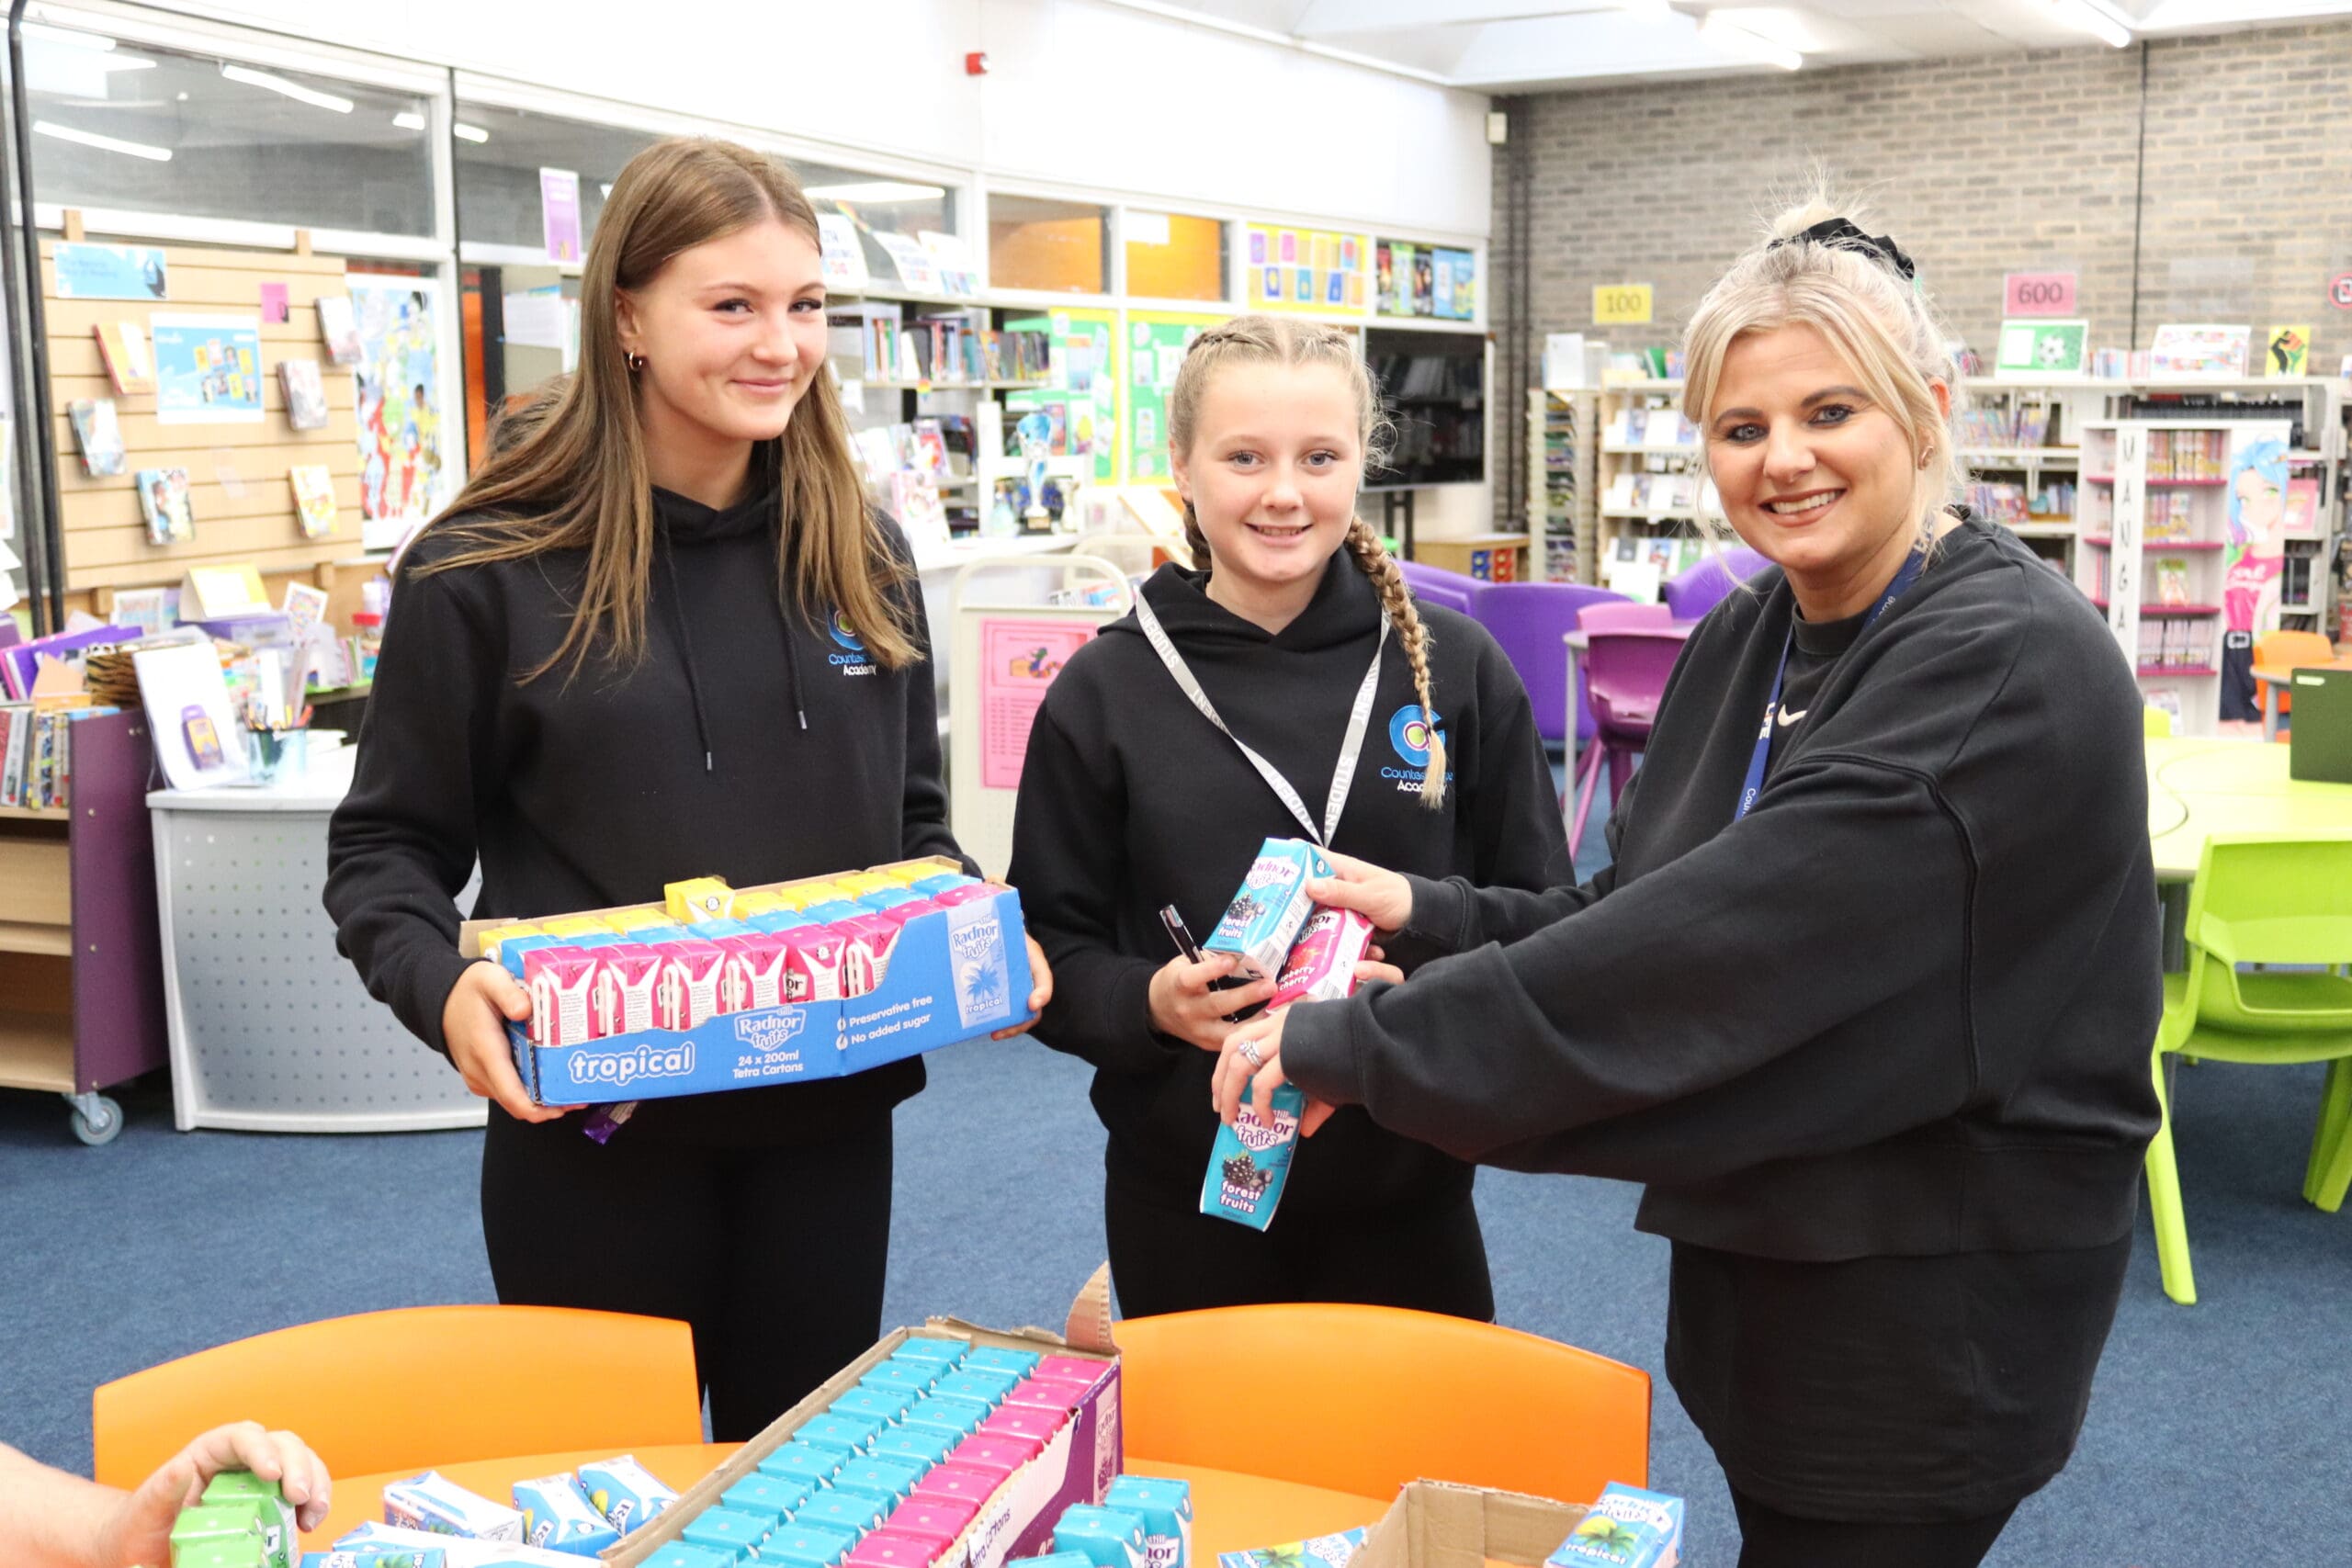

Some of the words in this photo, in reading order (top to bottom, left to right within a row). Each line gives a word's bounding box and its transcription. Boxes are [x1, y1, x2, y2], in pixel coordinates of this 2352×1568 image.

[1606, 292, 1642, 313] 100
[2018, 282, 2064, 304] 600
[1140, 612, 1180, 669] STUDENT
[953, 924, 998, 947] Radnor
[1217, 927, 1244, 938] fruits
[961, 936, 993, 959] fruits
[1279, 975, 1309, 991] cherry
[849, 1002, 910, 1027] Preservative
[911, 996, 933, 1009] free
[966, 995, 1003, 1014] tropical
[739, 1014, 802, 1036] Radnor
[851, 1033, 866, 1045] No
[868, 1021, 900, 1040] added
[902, 1014, 932, 1029] sugar
[752, 1029, 789, 1051] fruits
[572, 1043, 691, 1083] tropical
[738, 1055, 753, 1066] 24
[754, 1056, 763, 1065] x
[763, 1049, 799, 1064] 200ml
[733, 1067, 761, 1079] Tetra
[762, 1063, 804, 1076] Cartons
[1236, 1109, 1294, 1135] ador
[1237, 1125, 1278, 1147] fruits
[1222, 1180, 1261, 1201] forest
[1220, 1193, 1255, 1213] fruits
[1565, 1543, 1628, 1565] tropical
